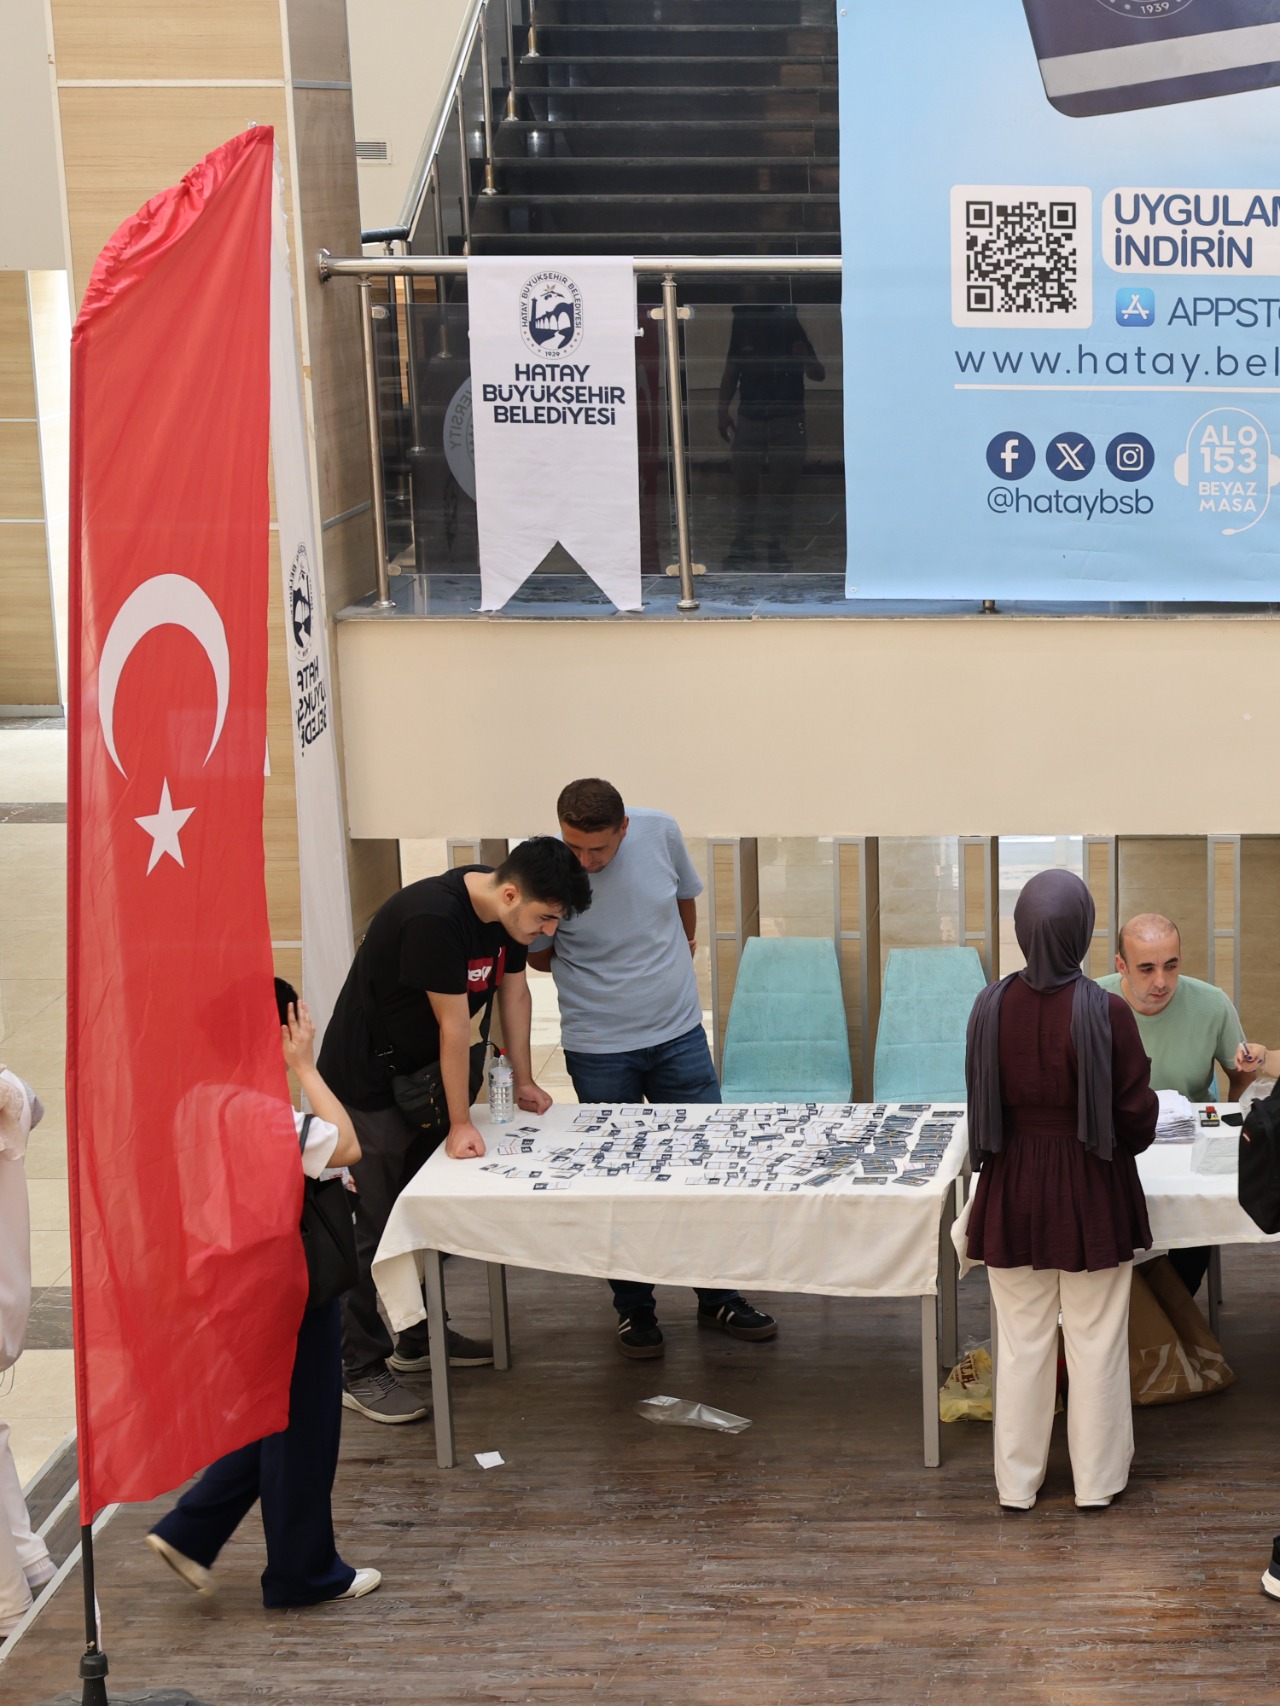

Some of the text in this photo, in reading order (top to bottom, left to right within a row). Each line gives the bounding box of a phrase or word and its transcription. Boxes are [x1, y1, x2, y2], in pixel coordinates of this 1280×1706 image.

[1141, 2, 1169, 13] 1939
[1114, 227, 1253, 269] İNDİRİN
[515, 363, 590, 382] HATAY
[482, 384, 626, 405] BÜYÜKŞEHİR
[494, 406, 616, 425] BELEDİYESİ
[1200, 425, 1257, 446] ALO
[1200, 446, 1257, 474] 153
[1198, 481, 1257, 497] BEYAZ
[986, 485, 1154, 520] @hataybsb
[1199, 498, 1257, 512] MASA
